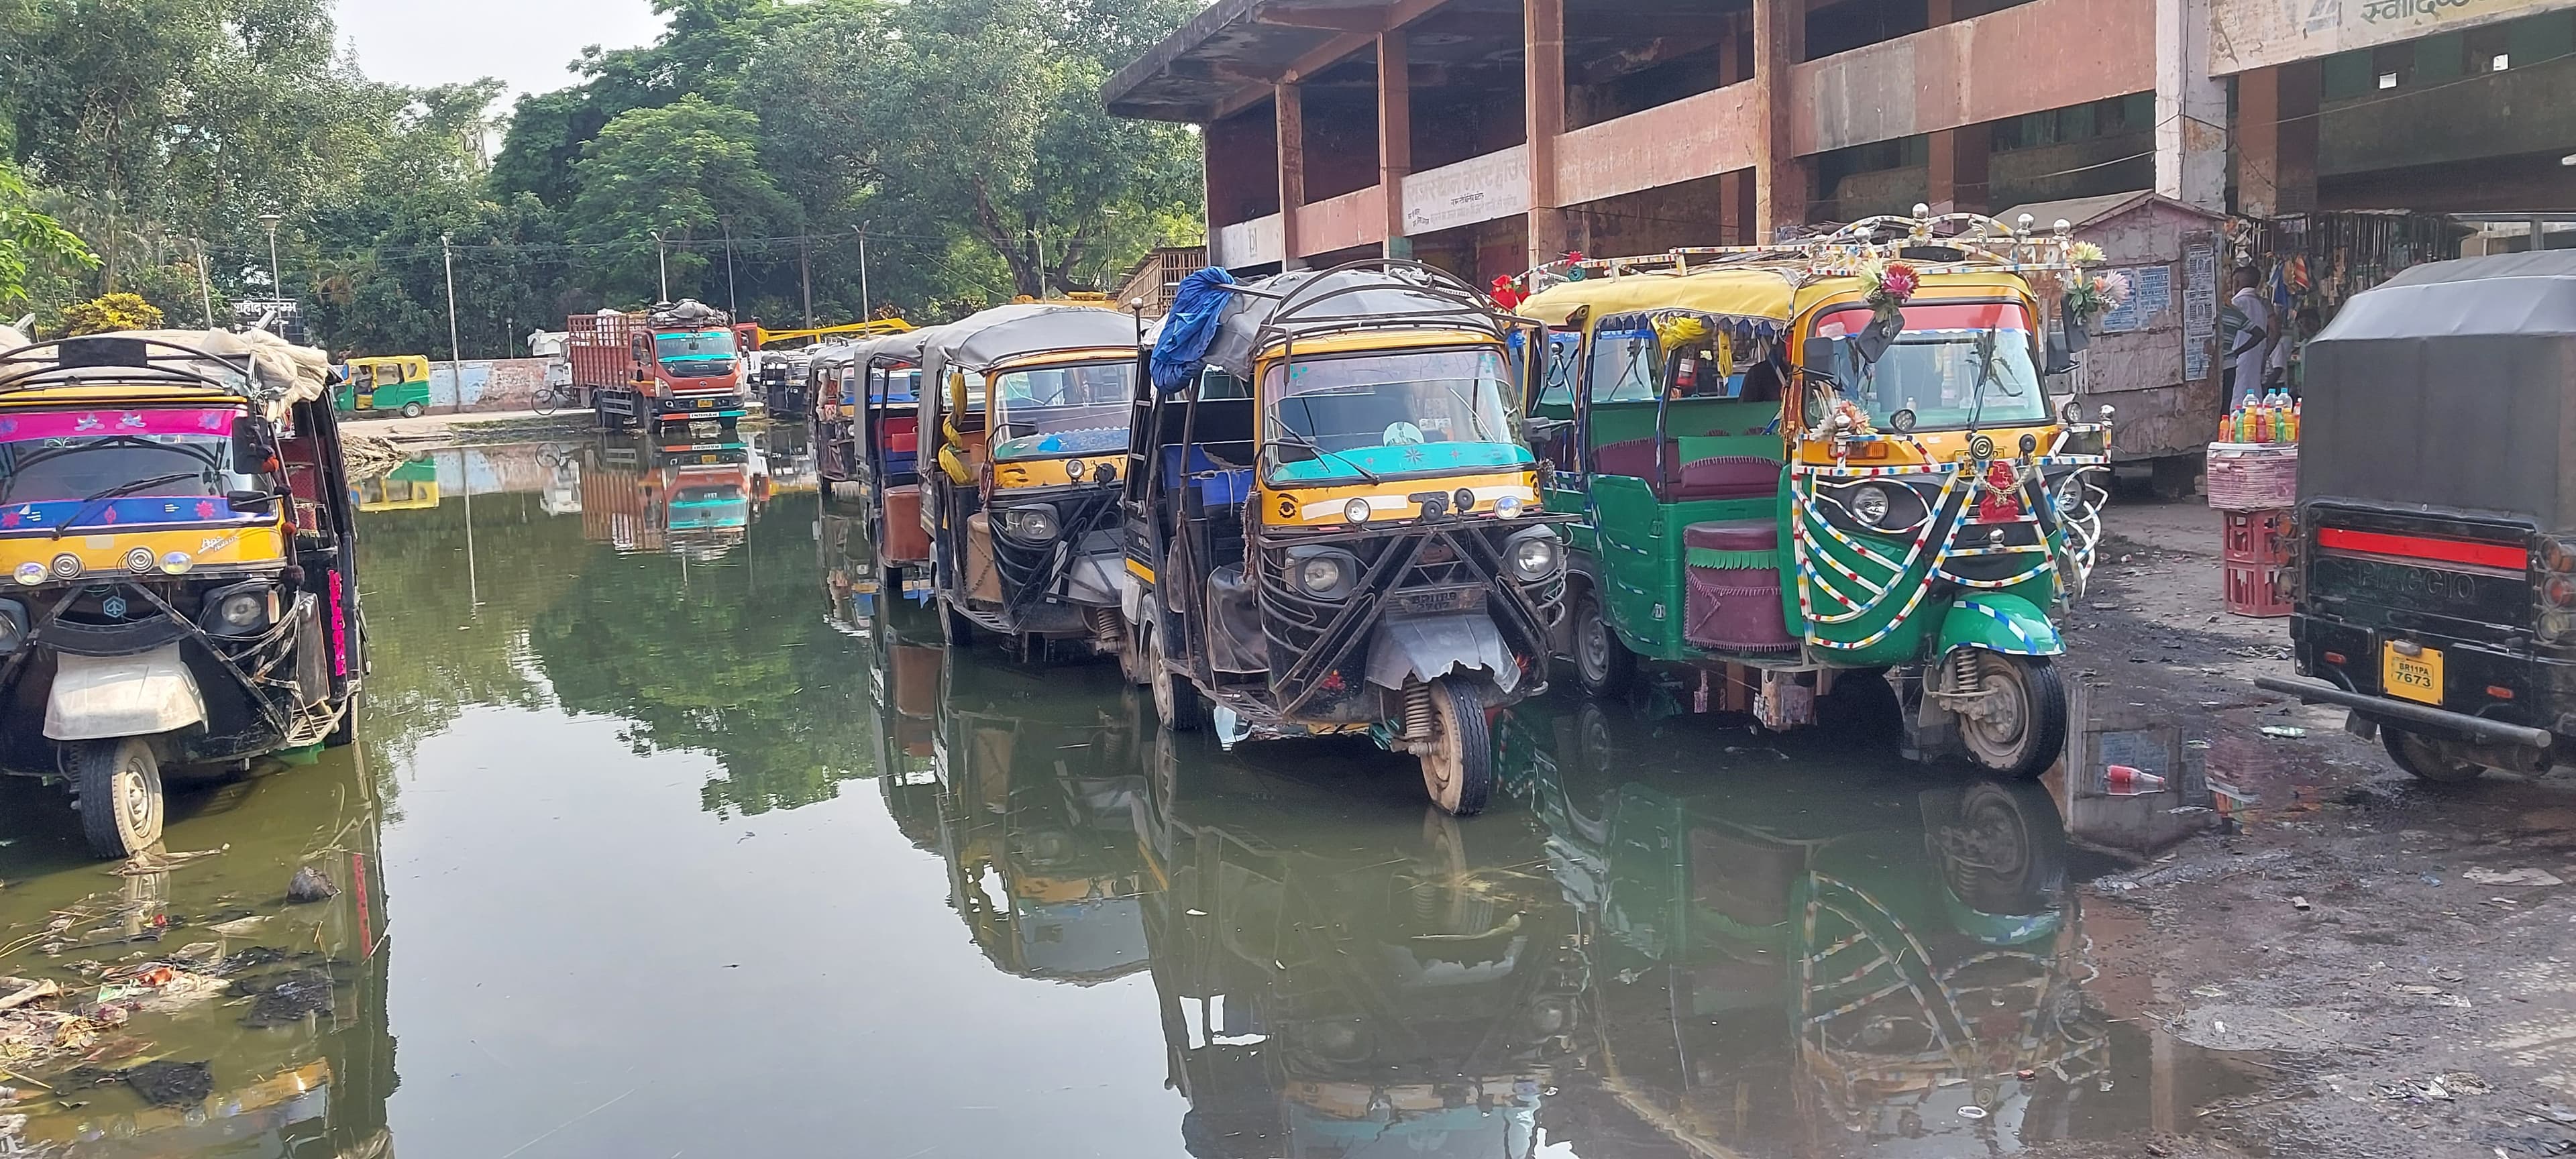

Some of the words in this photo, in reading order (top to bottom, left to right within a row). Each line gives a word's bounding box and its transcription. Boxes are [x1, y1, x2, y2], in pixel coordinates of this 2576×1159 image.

[2357, 561, 2476, 600] PIAGGIO
[2399, 663, 2428, 675] BR11PA
[2396, 671, 2431, 687] 7673
